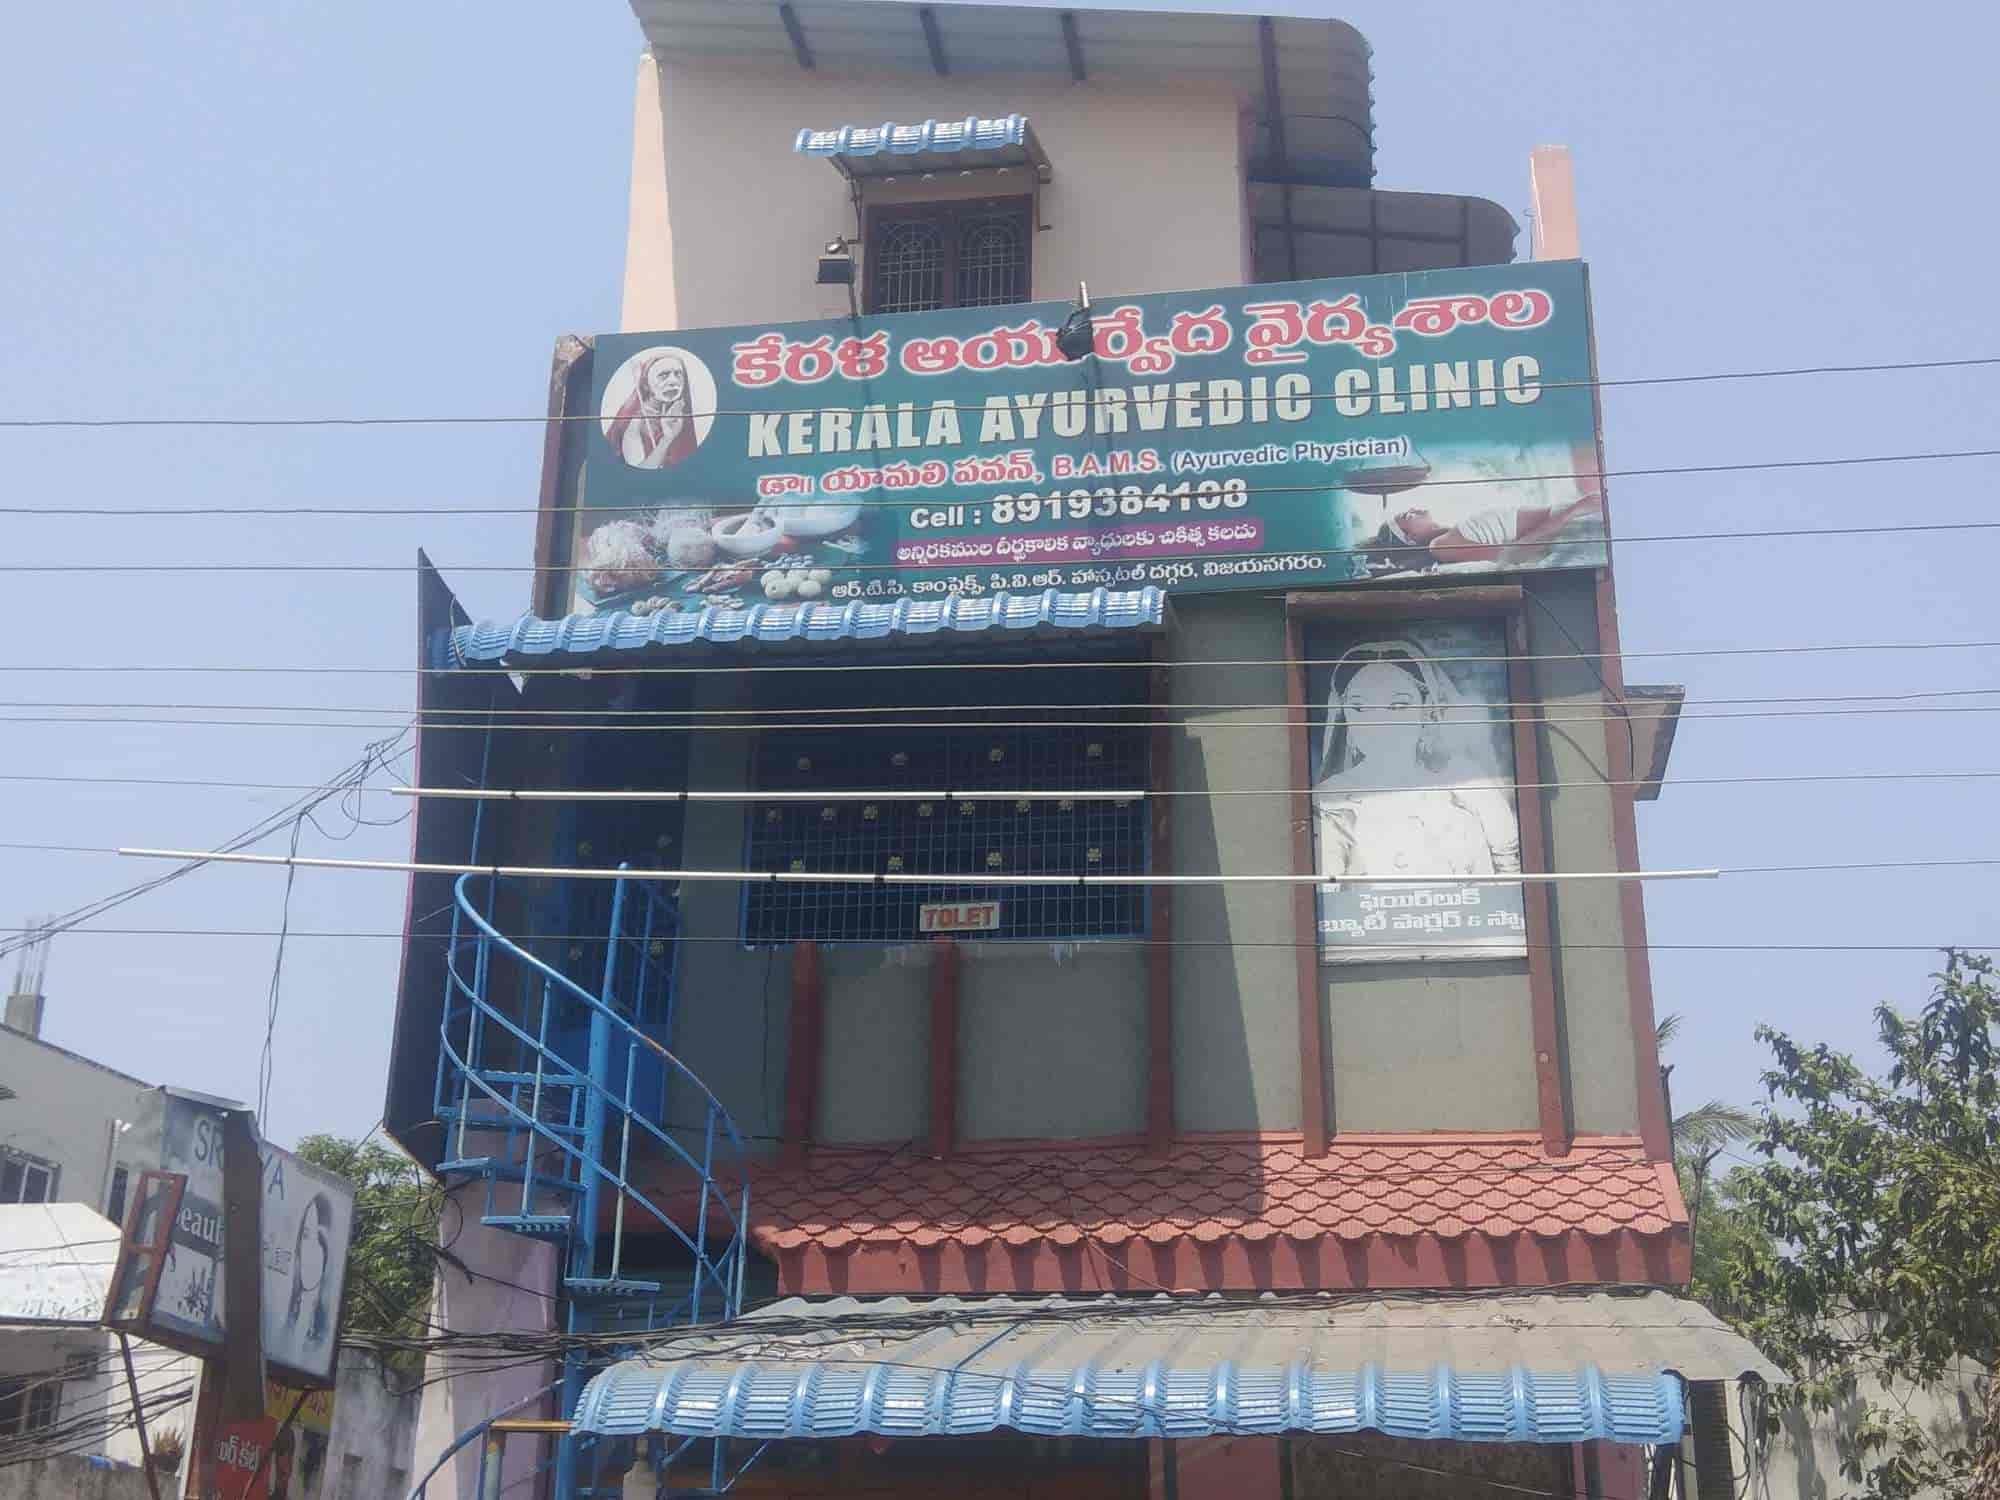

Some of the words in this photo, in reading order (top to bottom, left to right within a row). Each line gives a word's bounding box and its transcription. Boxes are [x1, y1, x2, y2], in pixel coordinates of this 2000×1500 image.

[731, 331, 890, 388] కేరళ
[1244, 289, 1552, 366] వైద్యశాల
[747, 400, 961, 457] KERALA
[979, 374, 1312, 442] AYURVEDIC
[1334, 356, 1541, 417] CLINIC
[1053, 450, 1164, 478] B.A.M.S.
[1172, 446, 1287, 473] (Ayurvedic
[1295, 436, 1409, 463] Physician)
[910, 506, 963, 528] Cell
